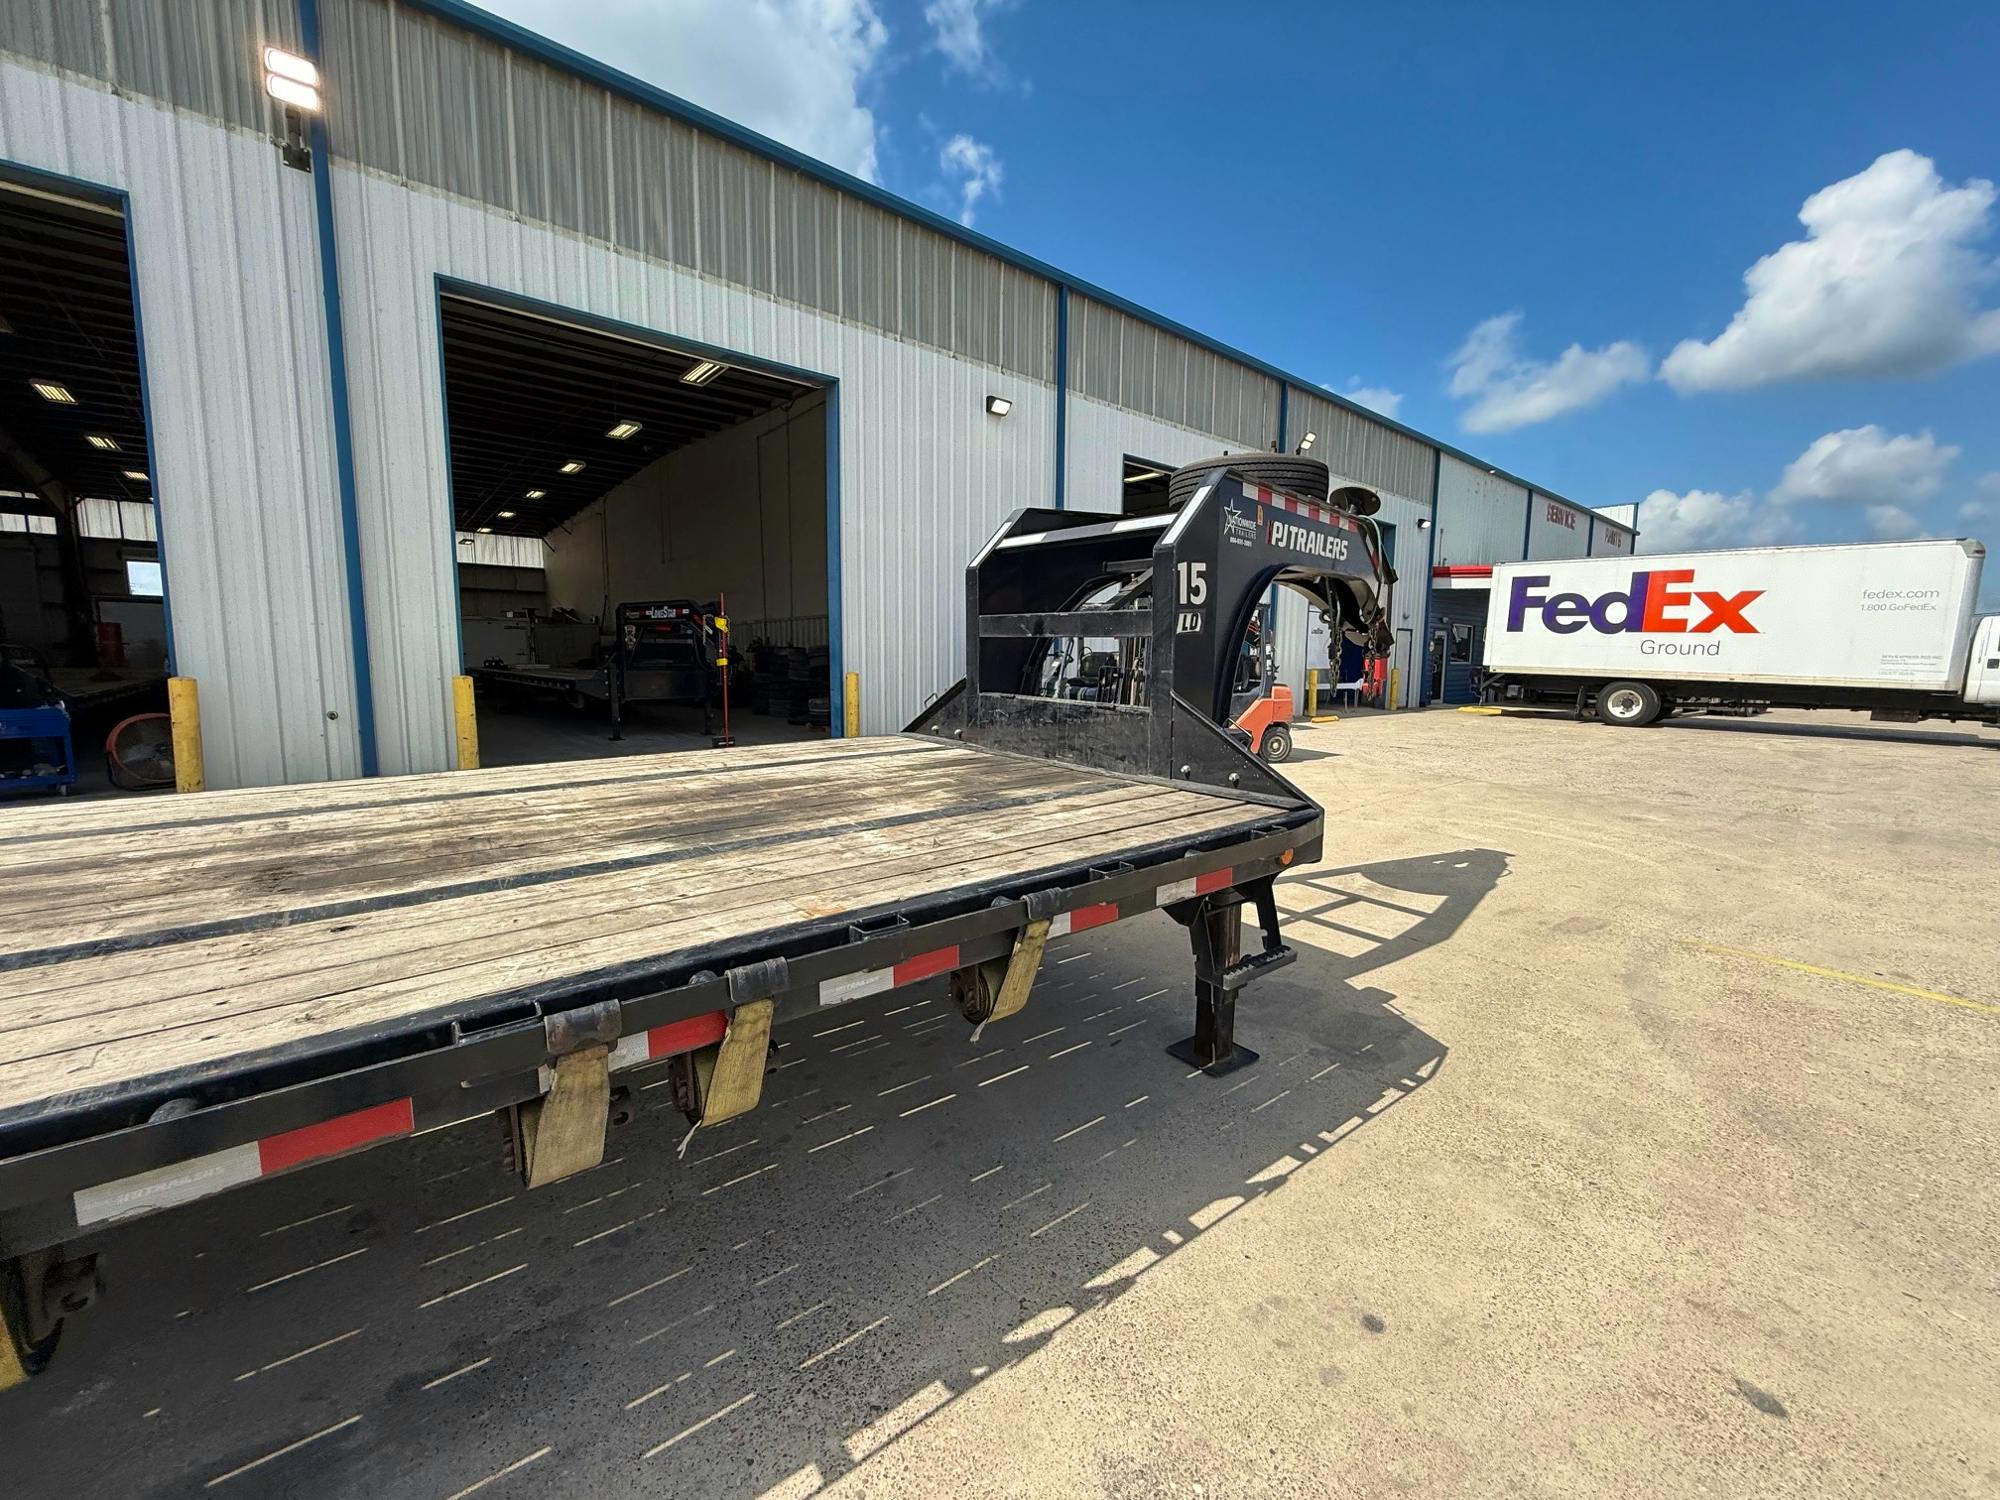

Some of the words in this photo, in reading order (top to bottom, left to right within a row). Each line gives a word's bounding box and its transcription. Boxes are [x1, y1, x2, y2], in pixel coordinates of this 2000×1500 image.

[1177, 561, 1207, 605] 15
[1862, 589, 1940, 600] fedex.com
[1506, 569, 1767, 635] FedEx
[1640, 639, 1722, 657] Ground
